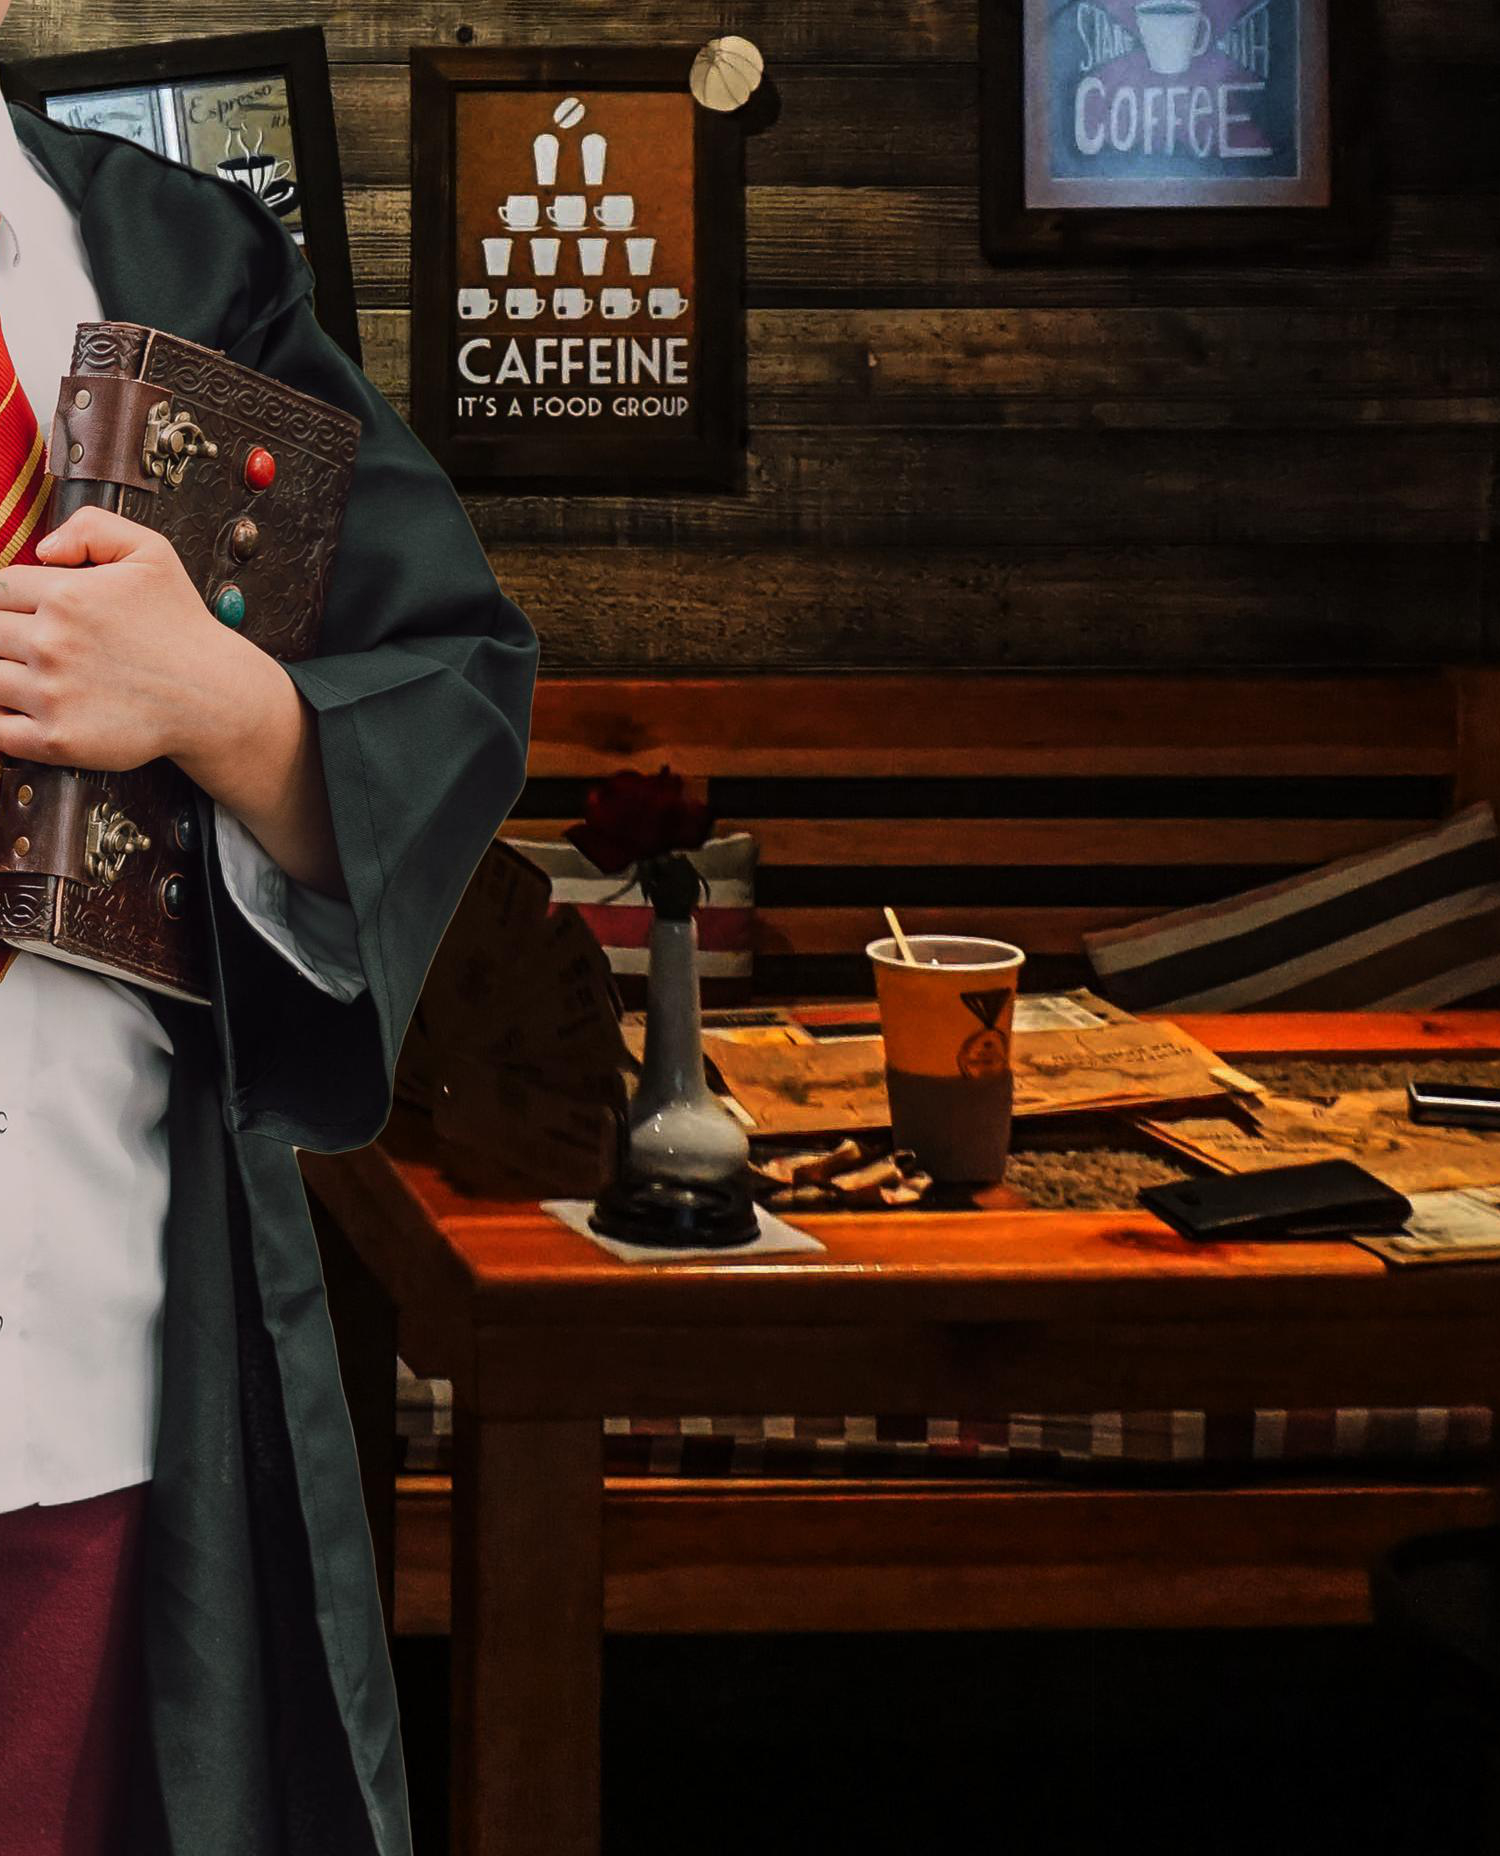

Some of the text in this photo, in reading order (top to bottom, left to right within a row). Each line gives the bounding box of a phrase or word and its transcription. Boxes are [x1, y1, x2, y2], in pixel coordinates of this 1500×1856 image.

[189, 84, 273, 125] Espresso
[458, 338, 688, 385] CAFFEINE
[457, 396, 688, 418] IT'S A FOOD GROUP
